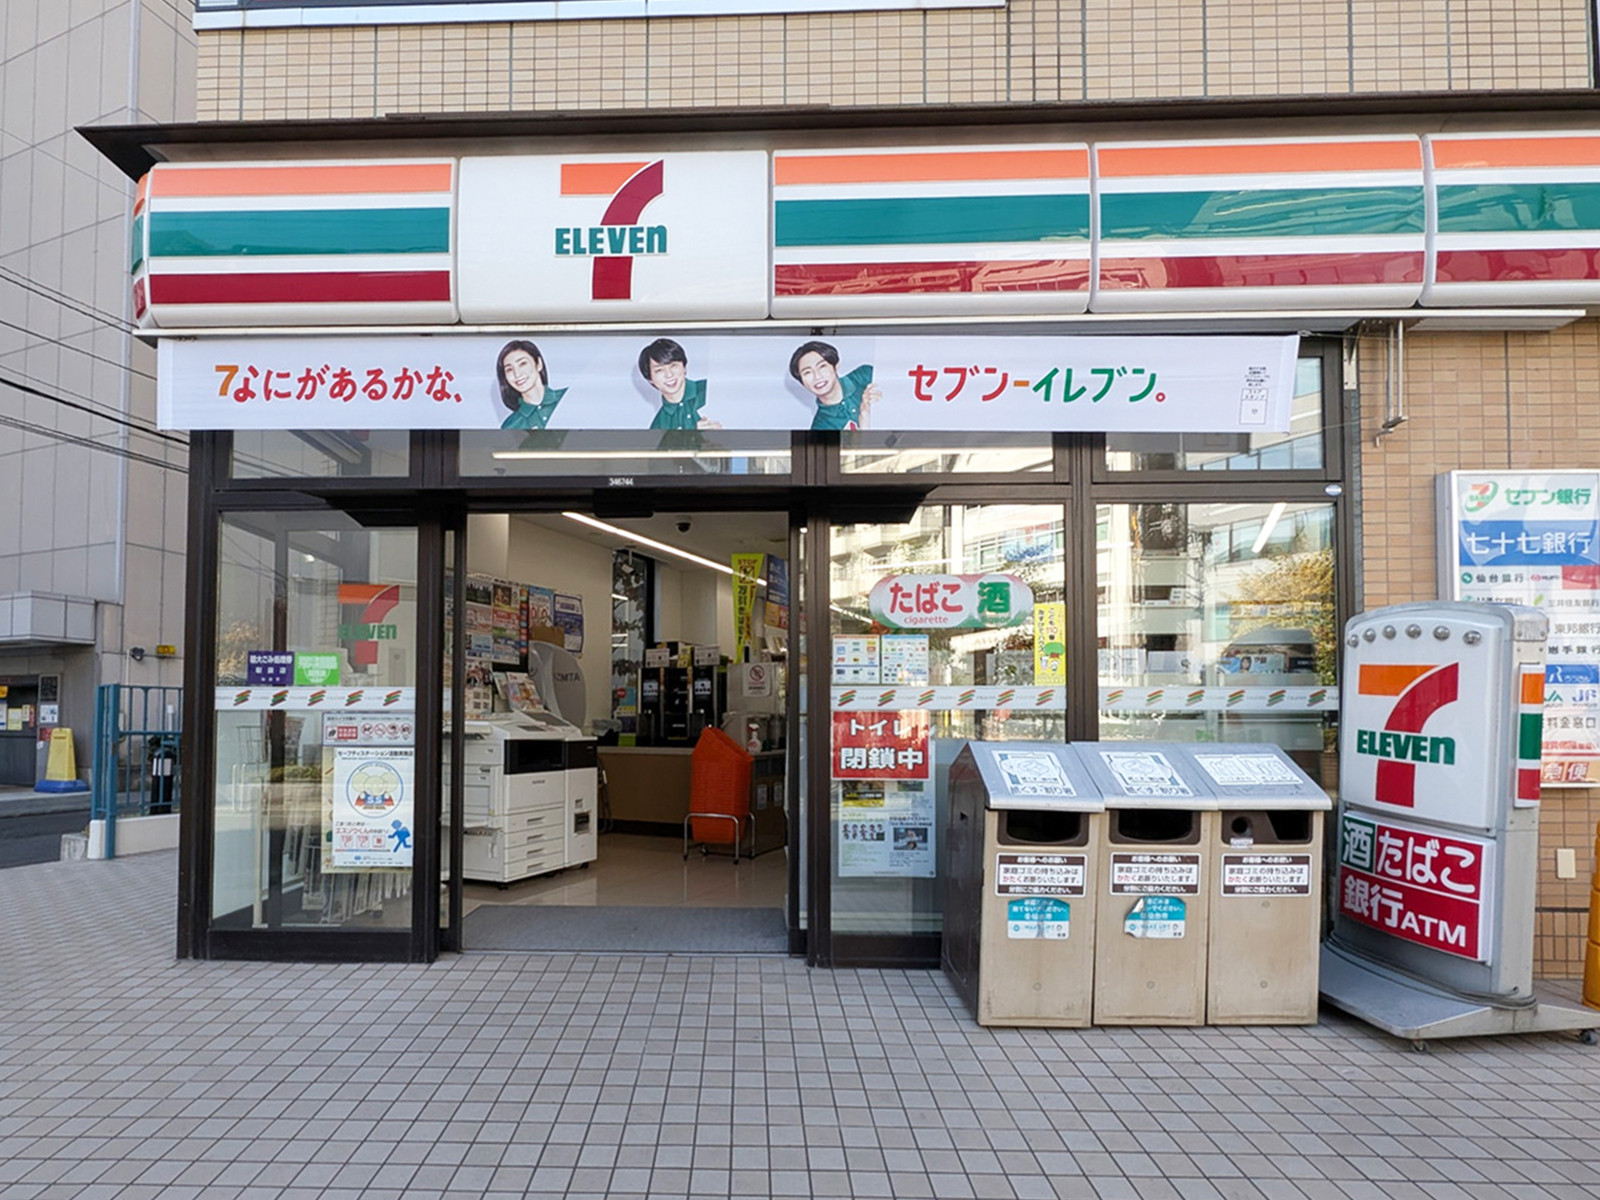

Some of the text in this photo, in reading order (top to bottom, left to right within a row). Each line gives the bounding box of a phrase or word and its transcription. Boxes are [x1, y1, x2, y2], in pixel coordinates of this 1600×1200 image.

[1504, 487, 1592, 506] セブン銀行
[1465, 531, 1591, 555] 七十七銀行
[1476, 573, 1524, 583] 仙台銀行
[889, 581, 1011, 614] たばこ 酒
[903, 616, 949, 625] cigarette
[850, 718, 912, 737] トイレ
[840, 747, 924, 770] 閉鎖中
[1343, 822, 1476, 894] 酒 たばこ
